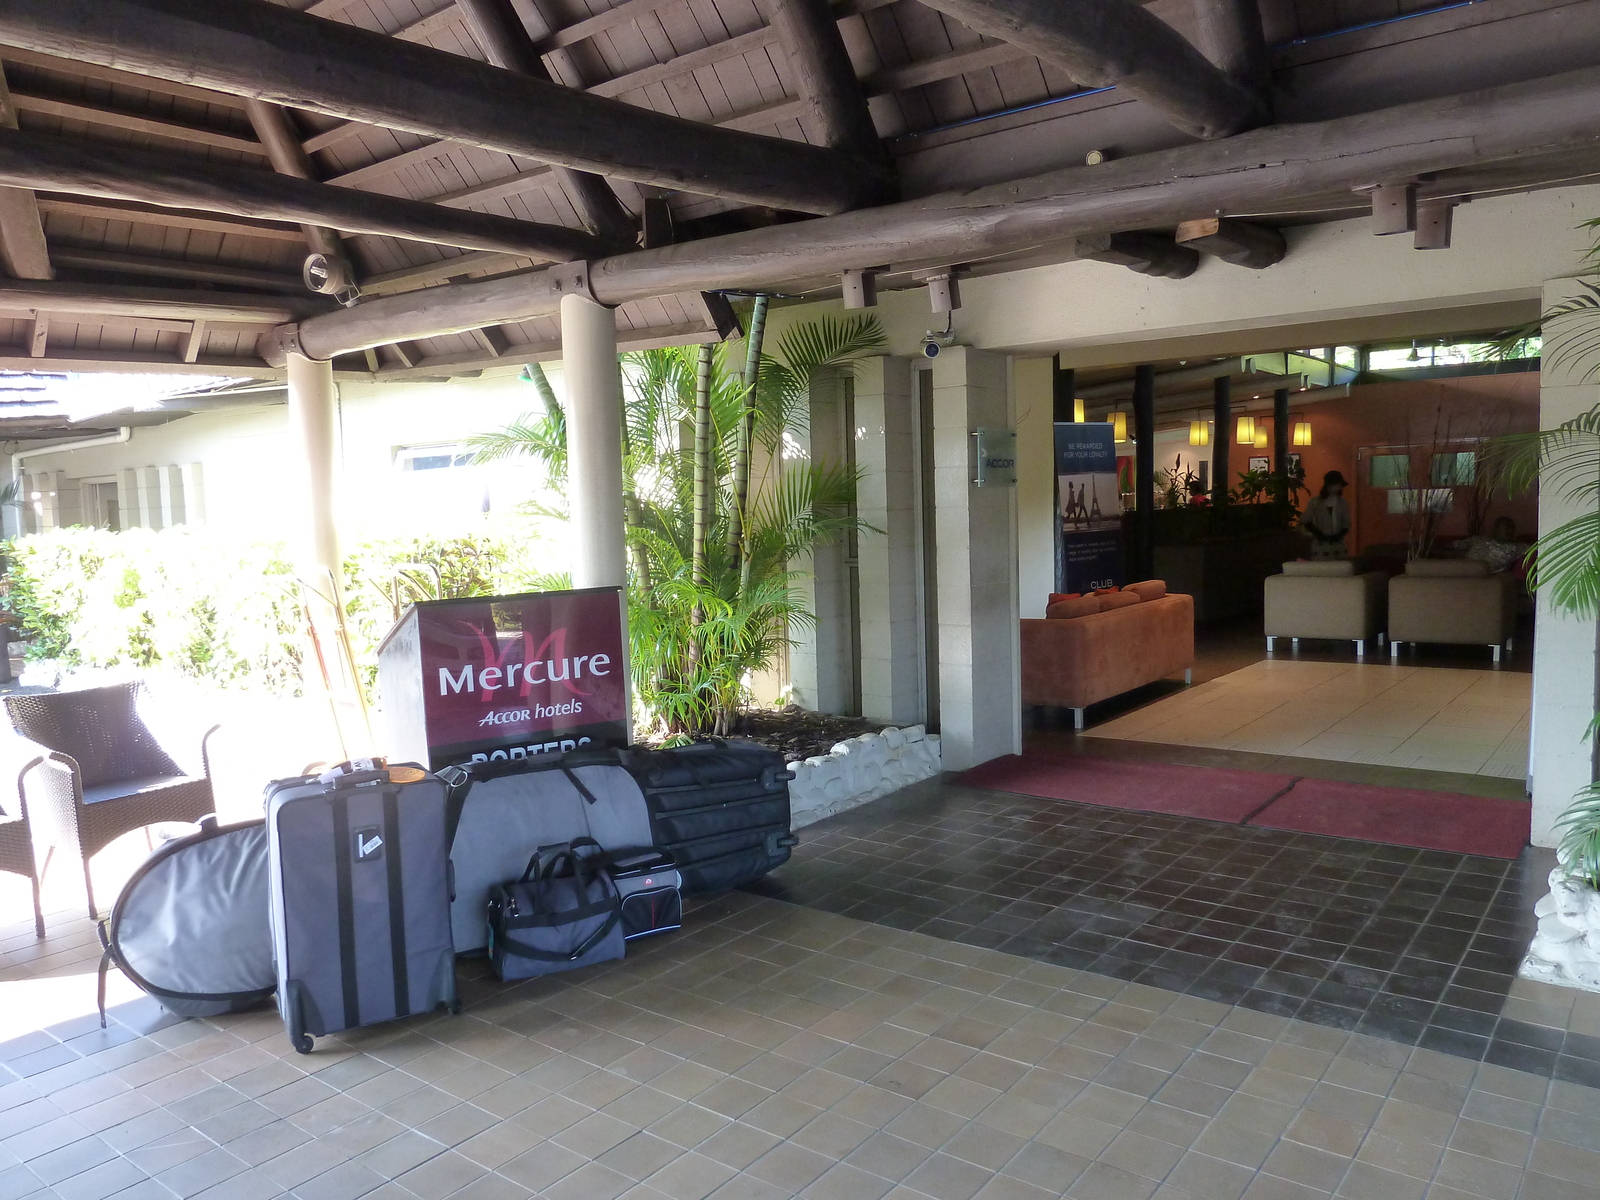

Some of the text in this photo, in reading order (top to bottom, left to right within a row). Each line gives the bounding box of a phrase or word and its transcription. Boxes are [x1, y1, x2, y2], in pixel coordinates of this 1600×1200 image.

[1068, 442, 1103, 450] BE REWARDED
[1063, 450, 1108, 459] FOR YOUR LOYALTY
[986, 458, 1015, 469] ACCOR
[1090, 579, 1113, 590] CLUB
[438, 652, 611, 696] Mercure
[478, 698, 583, 727] ACCOR hotels
